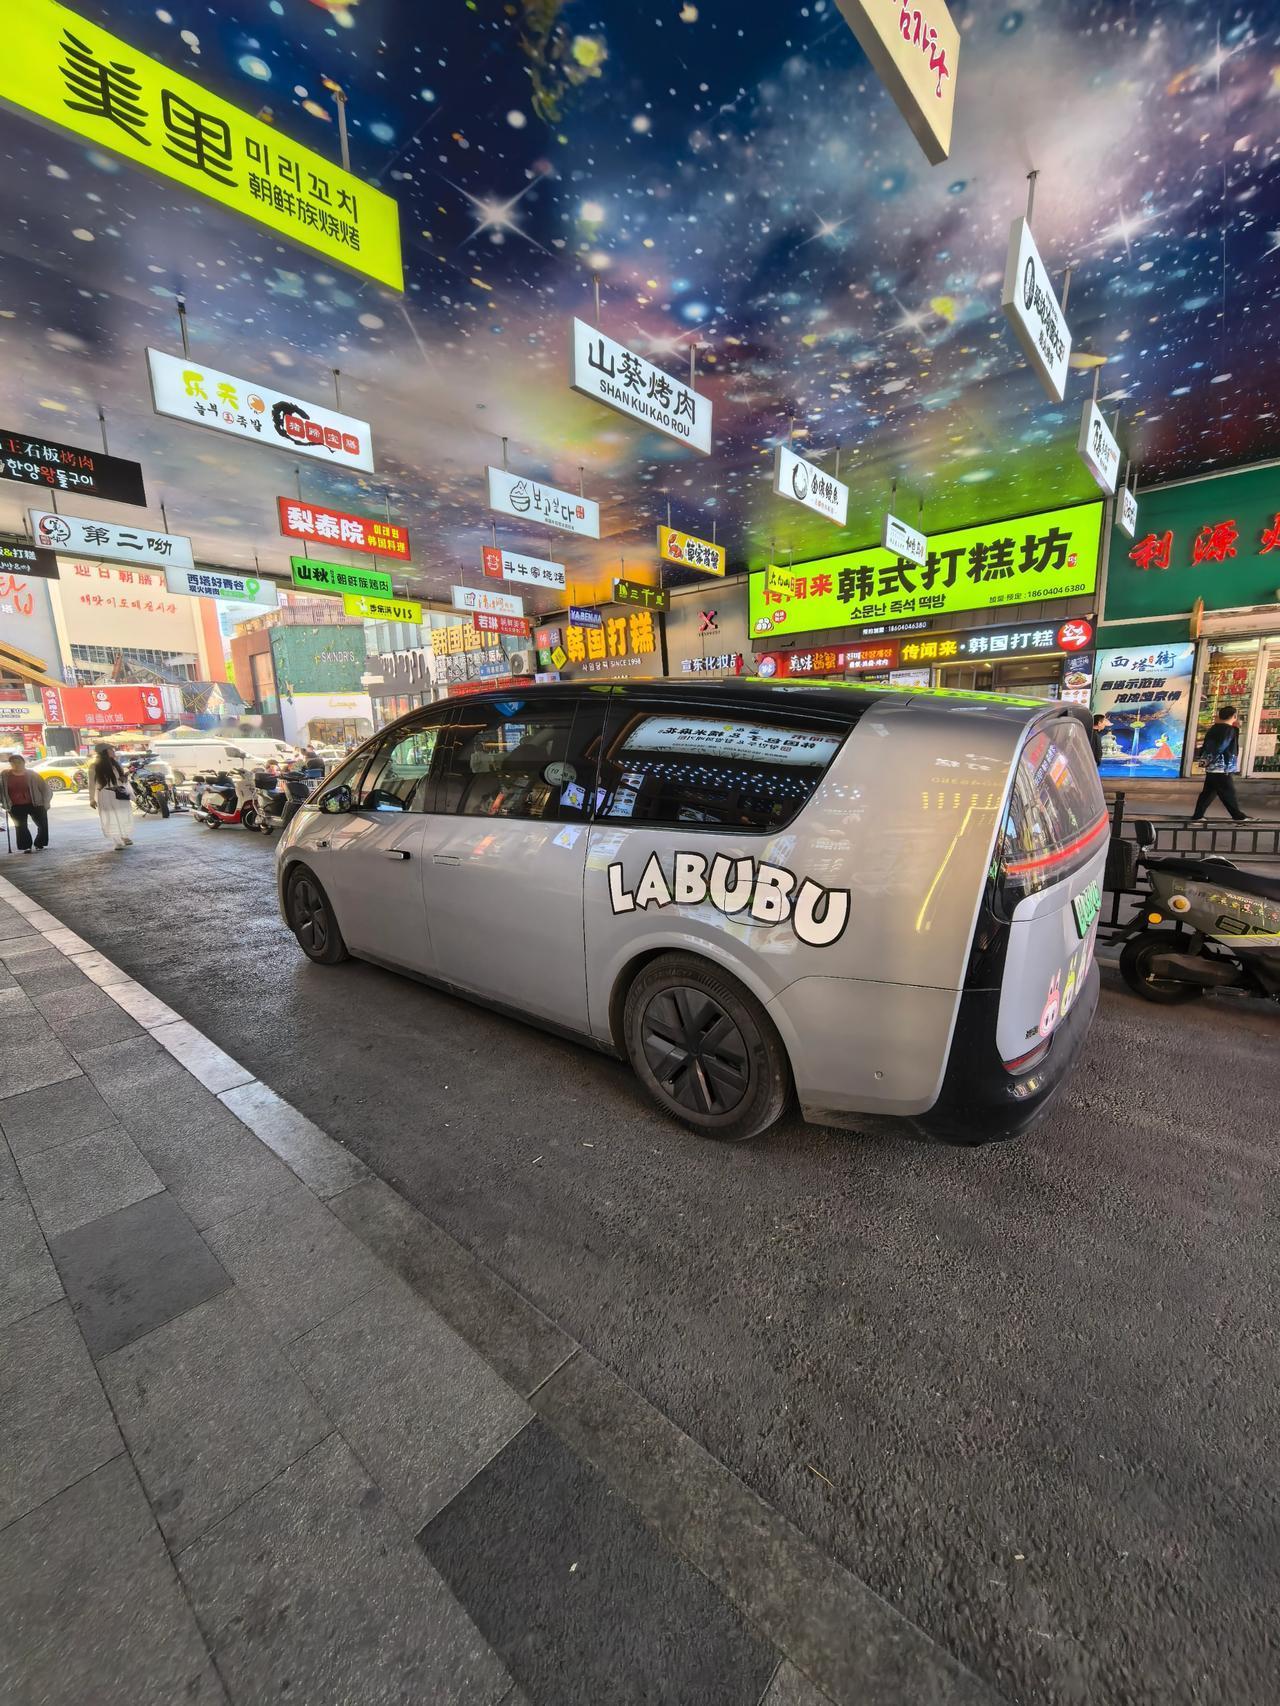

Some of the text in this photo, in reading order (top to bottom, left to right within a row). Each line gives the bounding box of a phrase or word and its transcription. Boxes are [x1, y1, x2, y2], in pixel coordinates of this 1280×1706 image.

[58, 27, 239, 188] 美里
[245, 136, 358, 223] 미리꼬치
[248, 172, 360, 251] 朝鲜族烧烤
[588, 338, 696, 425] 山葵烤肉
[600, 379, 690, 437] SHAN KUI KAO ROU
[6, 458, 94, 489] 한양왕돌구이
[82, 525, 173, 556] 第二呦
[287, 506, 365, 545] 梨泰院
[297, 565, 329, 582] 山秋
[837, 526, 1073, 604] 韩式打糕坊
[850, 593, 946, 621] 소문난 즉석 떡방
[1027, 588, 1042, 599] 186
[1043, 586, 1063, 597] 0404
[1065, 583, 1086, 594] 6380
[393, 608, 412, 619] VIS
[888, 621, 927, 633] 18604046380
[610, 659, 627, 668] SINCE
[627, 658, 641, 666] 1998
[607, 850, 851, 948] LABUBU
